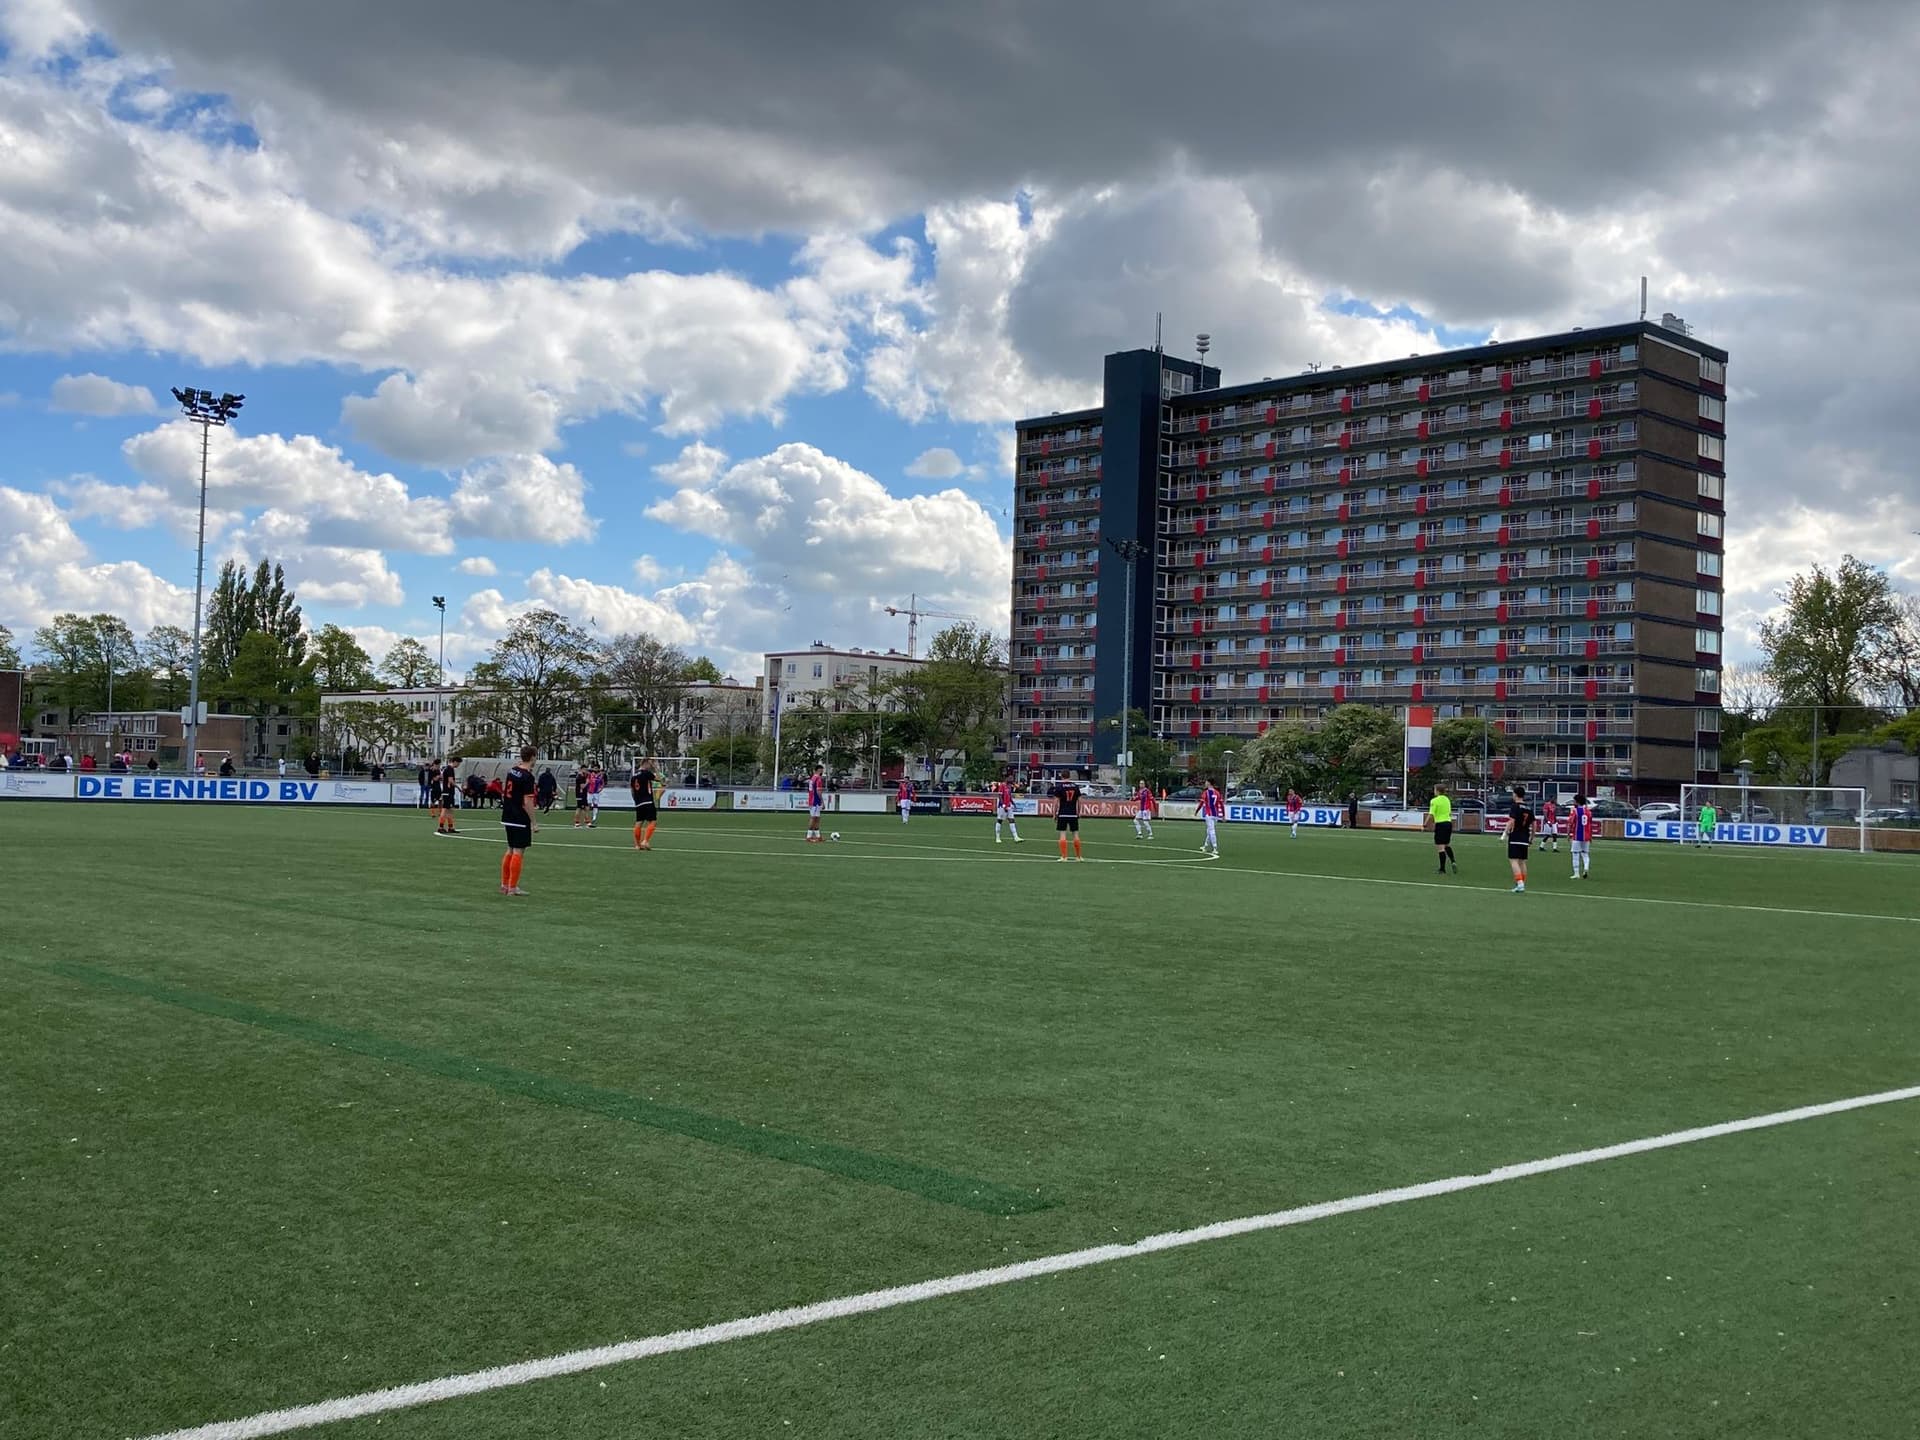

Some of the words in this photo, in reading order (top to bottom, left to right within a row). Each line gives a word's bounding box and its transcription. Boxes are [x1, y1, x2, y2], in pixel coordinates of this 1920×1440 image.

[79, 777, 123, 797] DE
[133, 779, 269, 800] EENHEID
[280, 782, 318, 801] BV
[1065, 790, 1075, 802] 17
[1211, 794, 1218, 805] 7
[1080, 802, 1100, 816] ING
[1230, 806, 1310, 822] EENHED
[1314, 810, 1340, 825] BV
[1581, 814, 1588, 826] 8
[1626, 821, 1659, 838] DE
[1666, 823, 1781, 842] EEHEID
[1788, 826, 1825, 844] BV
